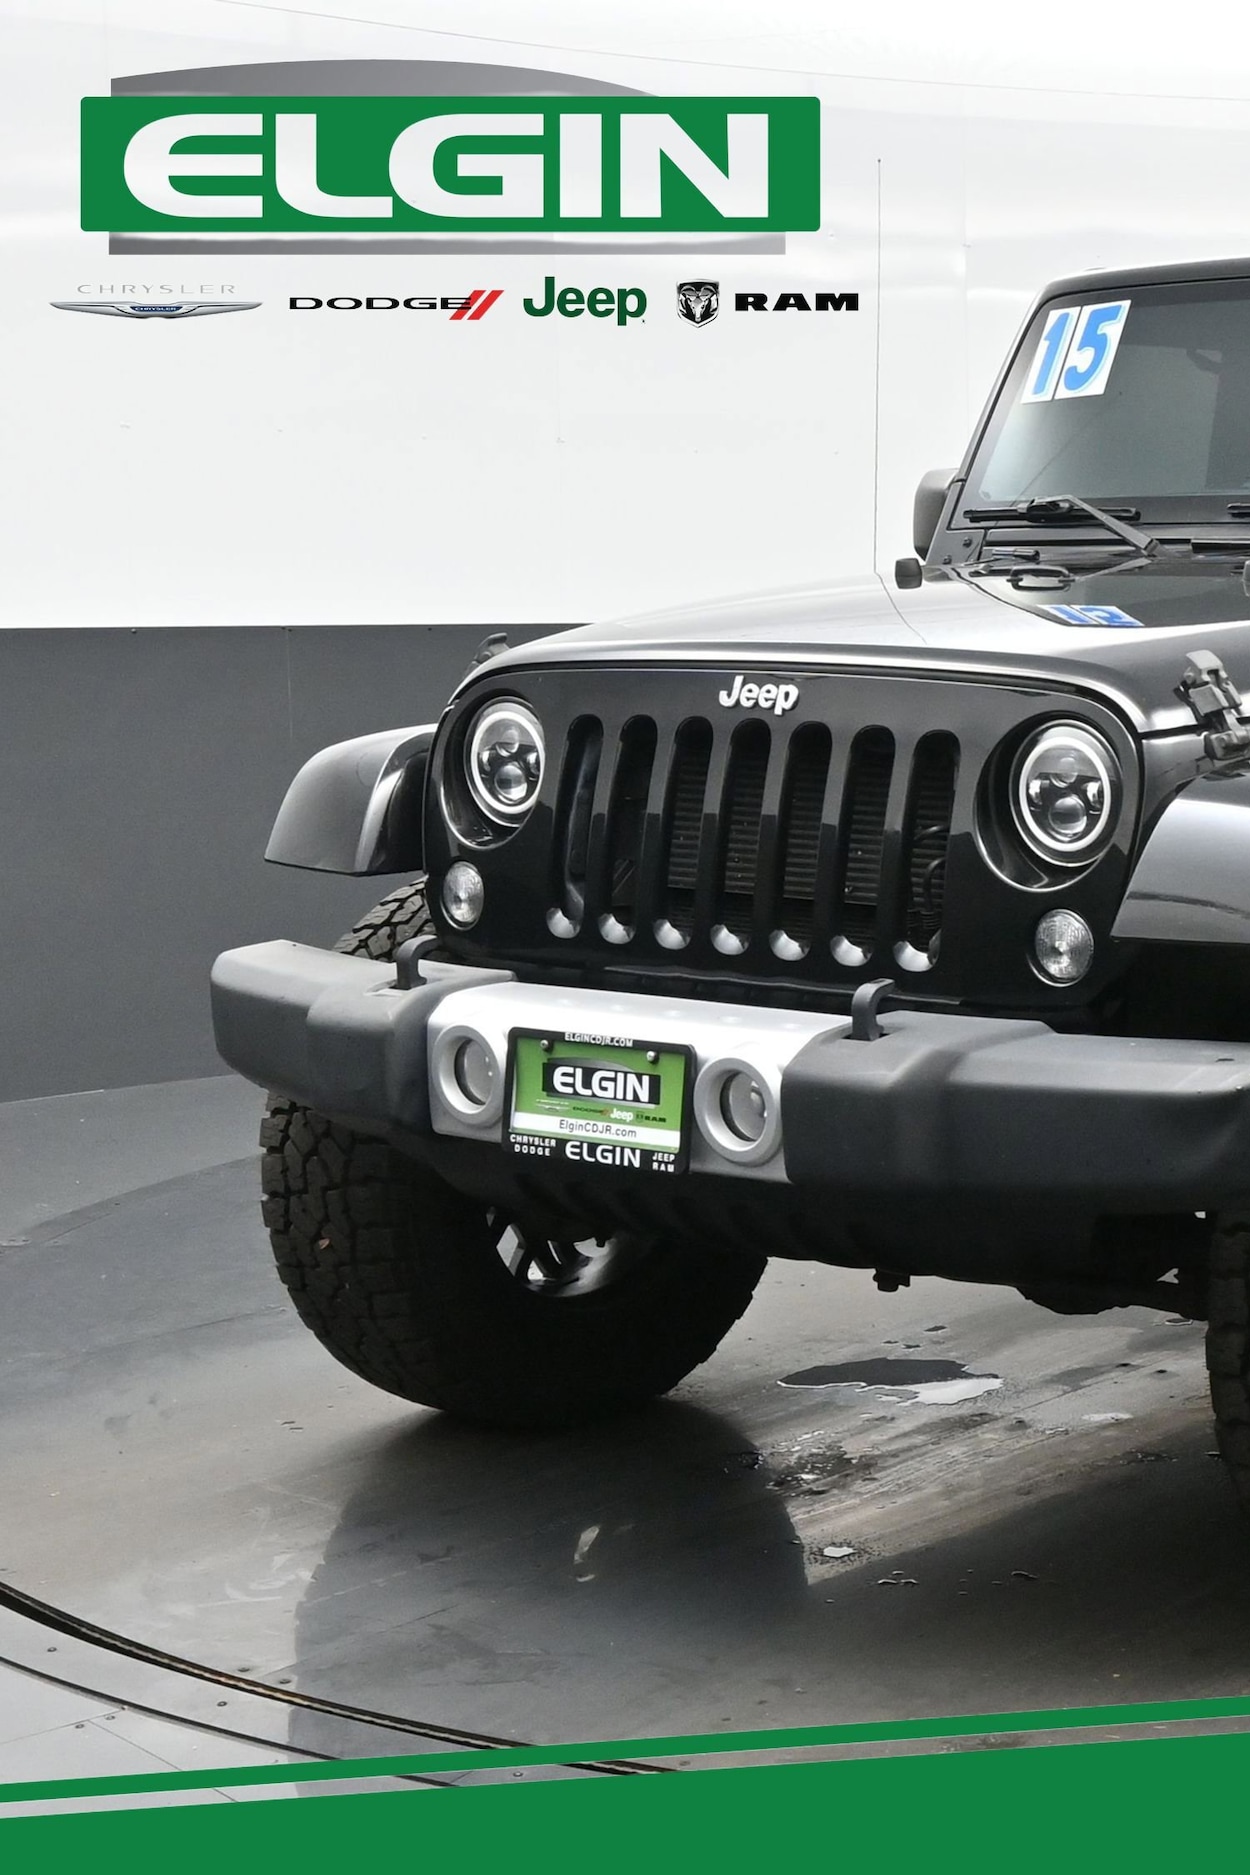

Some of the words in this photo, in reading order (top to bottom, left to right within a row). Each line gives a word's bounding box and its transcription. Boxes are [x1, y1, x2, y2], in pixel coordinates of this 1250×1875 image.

[1031, 303, 1127, 396] 15
[719, 675, 799, 715] Jeep
[565, 1031, 634, 1048] ELGINCDJR.COM
[553, 1066, 649, 1103] ELGIN
[610, 1108, 634, 1122] Jeep
[559, 1119, 637, 1138] ElginCDJR.com
[510, 1134, 557, 1147] CHRYSLER
[514, 1145, 551, 1157] DODGE
[565, 1141, 642, 1168] ELGIN
[652, 1152, 676, 1162] JEEP
[652, 1162, 675, 1172] RAM
